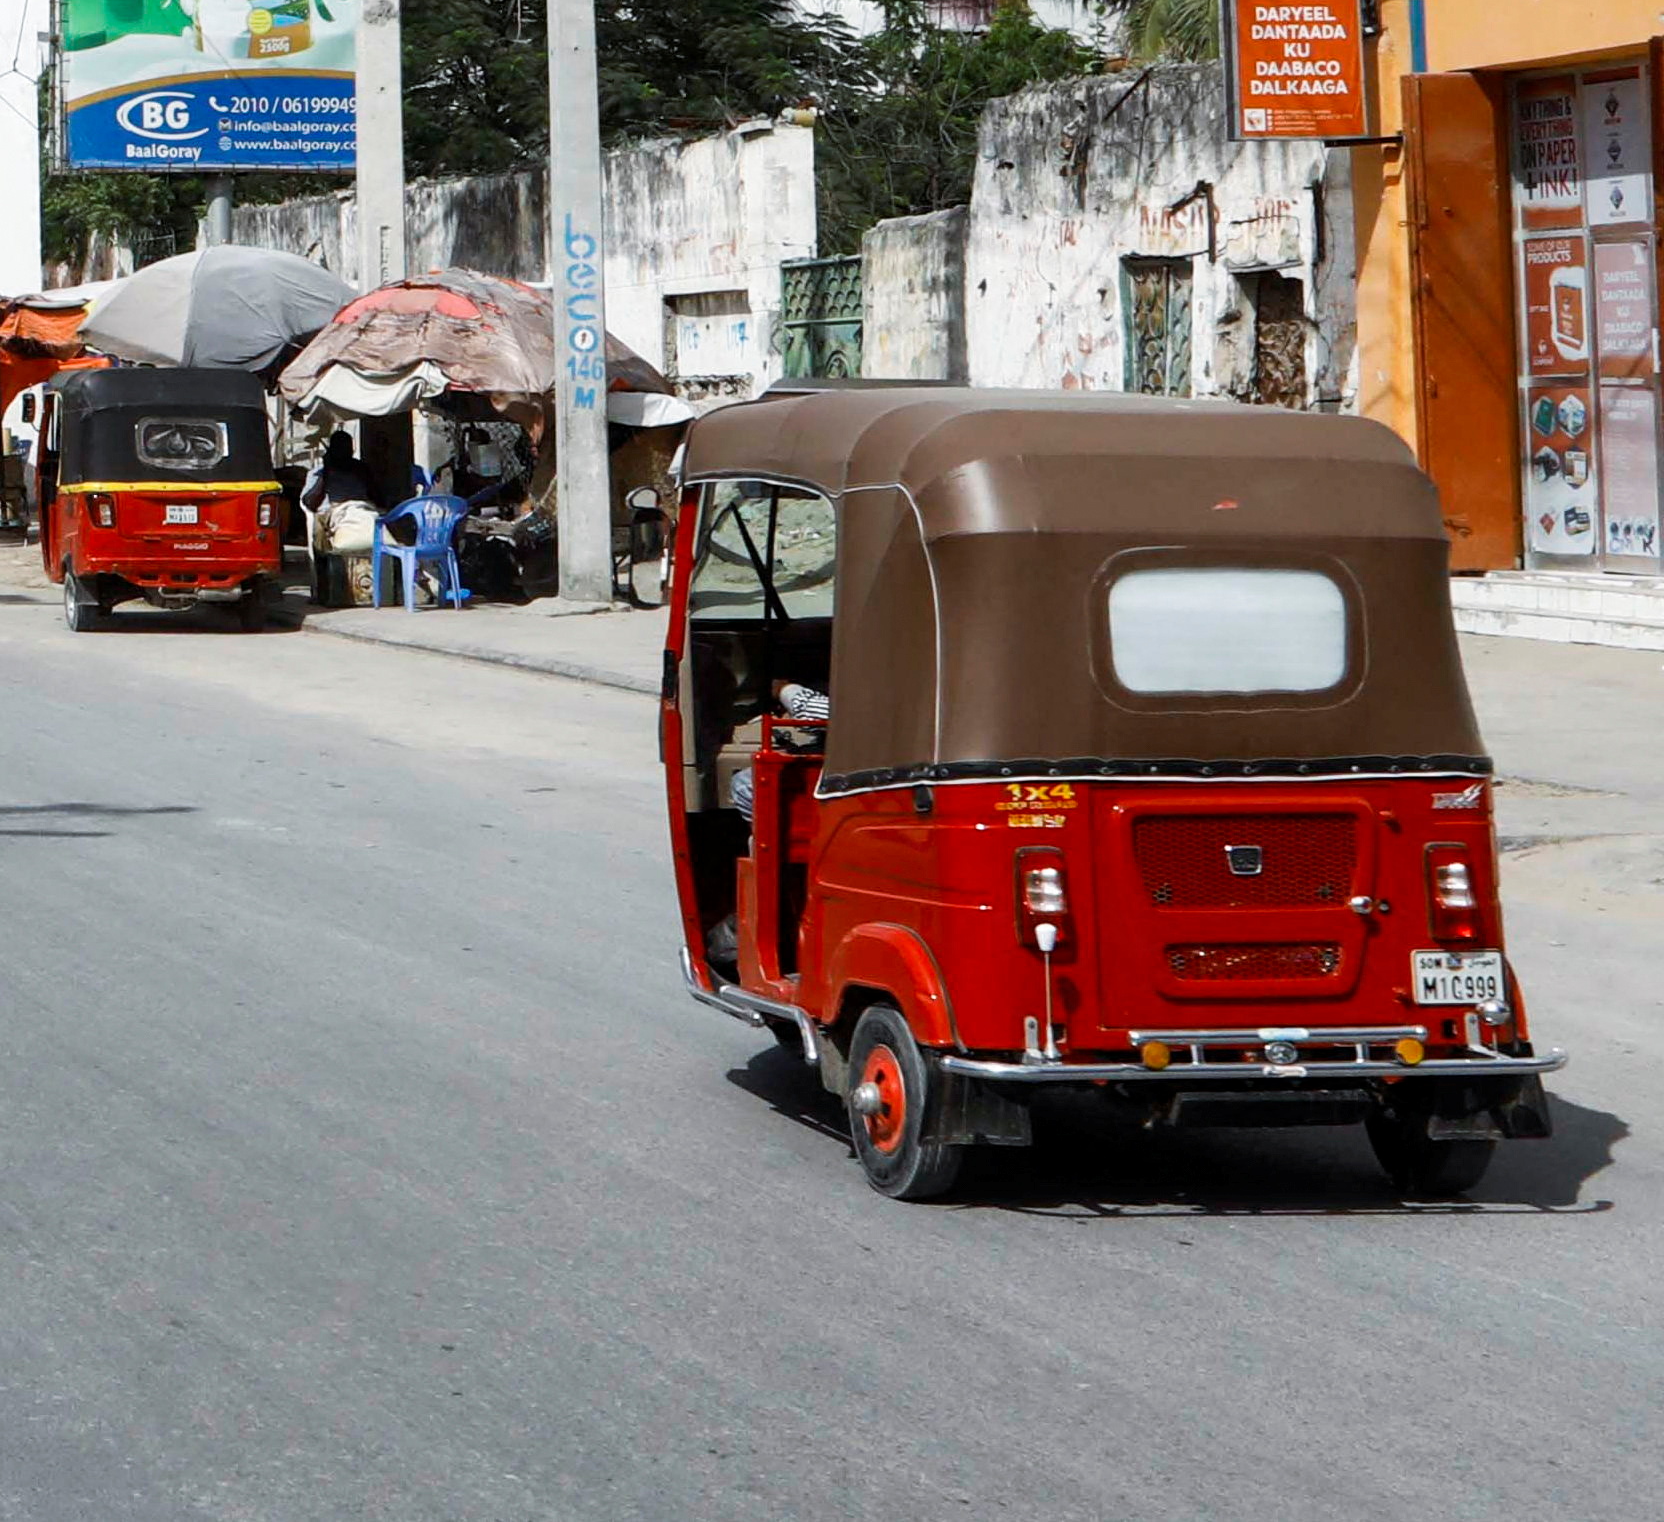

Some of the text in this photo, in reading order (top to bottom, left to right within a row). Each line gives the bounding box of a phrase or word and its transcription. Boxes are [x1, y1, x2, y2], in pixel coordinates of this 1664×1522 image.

[1255, 6, 1337, 22] DARYEEL
[1251, 25, 1347, 40] DANTAADA
[1284, 43, 1310, 57] KU
[1256, 61, 1341, 75] DAABACO
[1250, 80, 1349, 95] DALKAAGA
[230, 97, 269, 114] 2010
[142, 100, 190, 129] BG
[126, 143, 202, 160] BaalGoray
[1538, 138, 1576, 167] PAPER
[1527, 250, 1572, 264] PRODUCTS
[566, 355, 604, 382] 146
[574, 386, 596, 410] M
[1420, 958, 1442, 969] SOM
